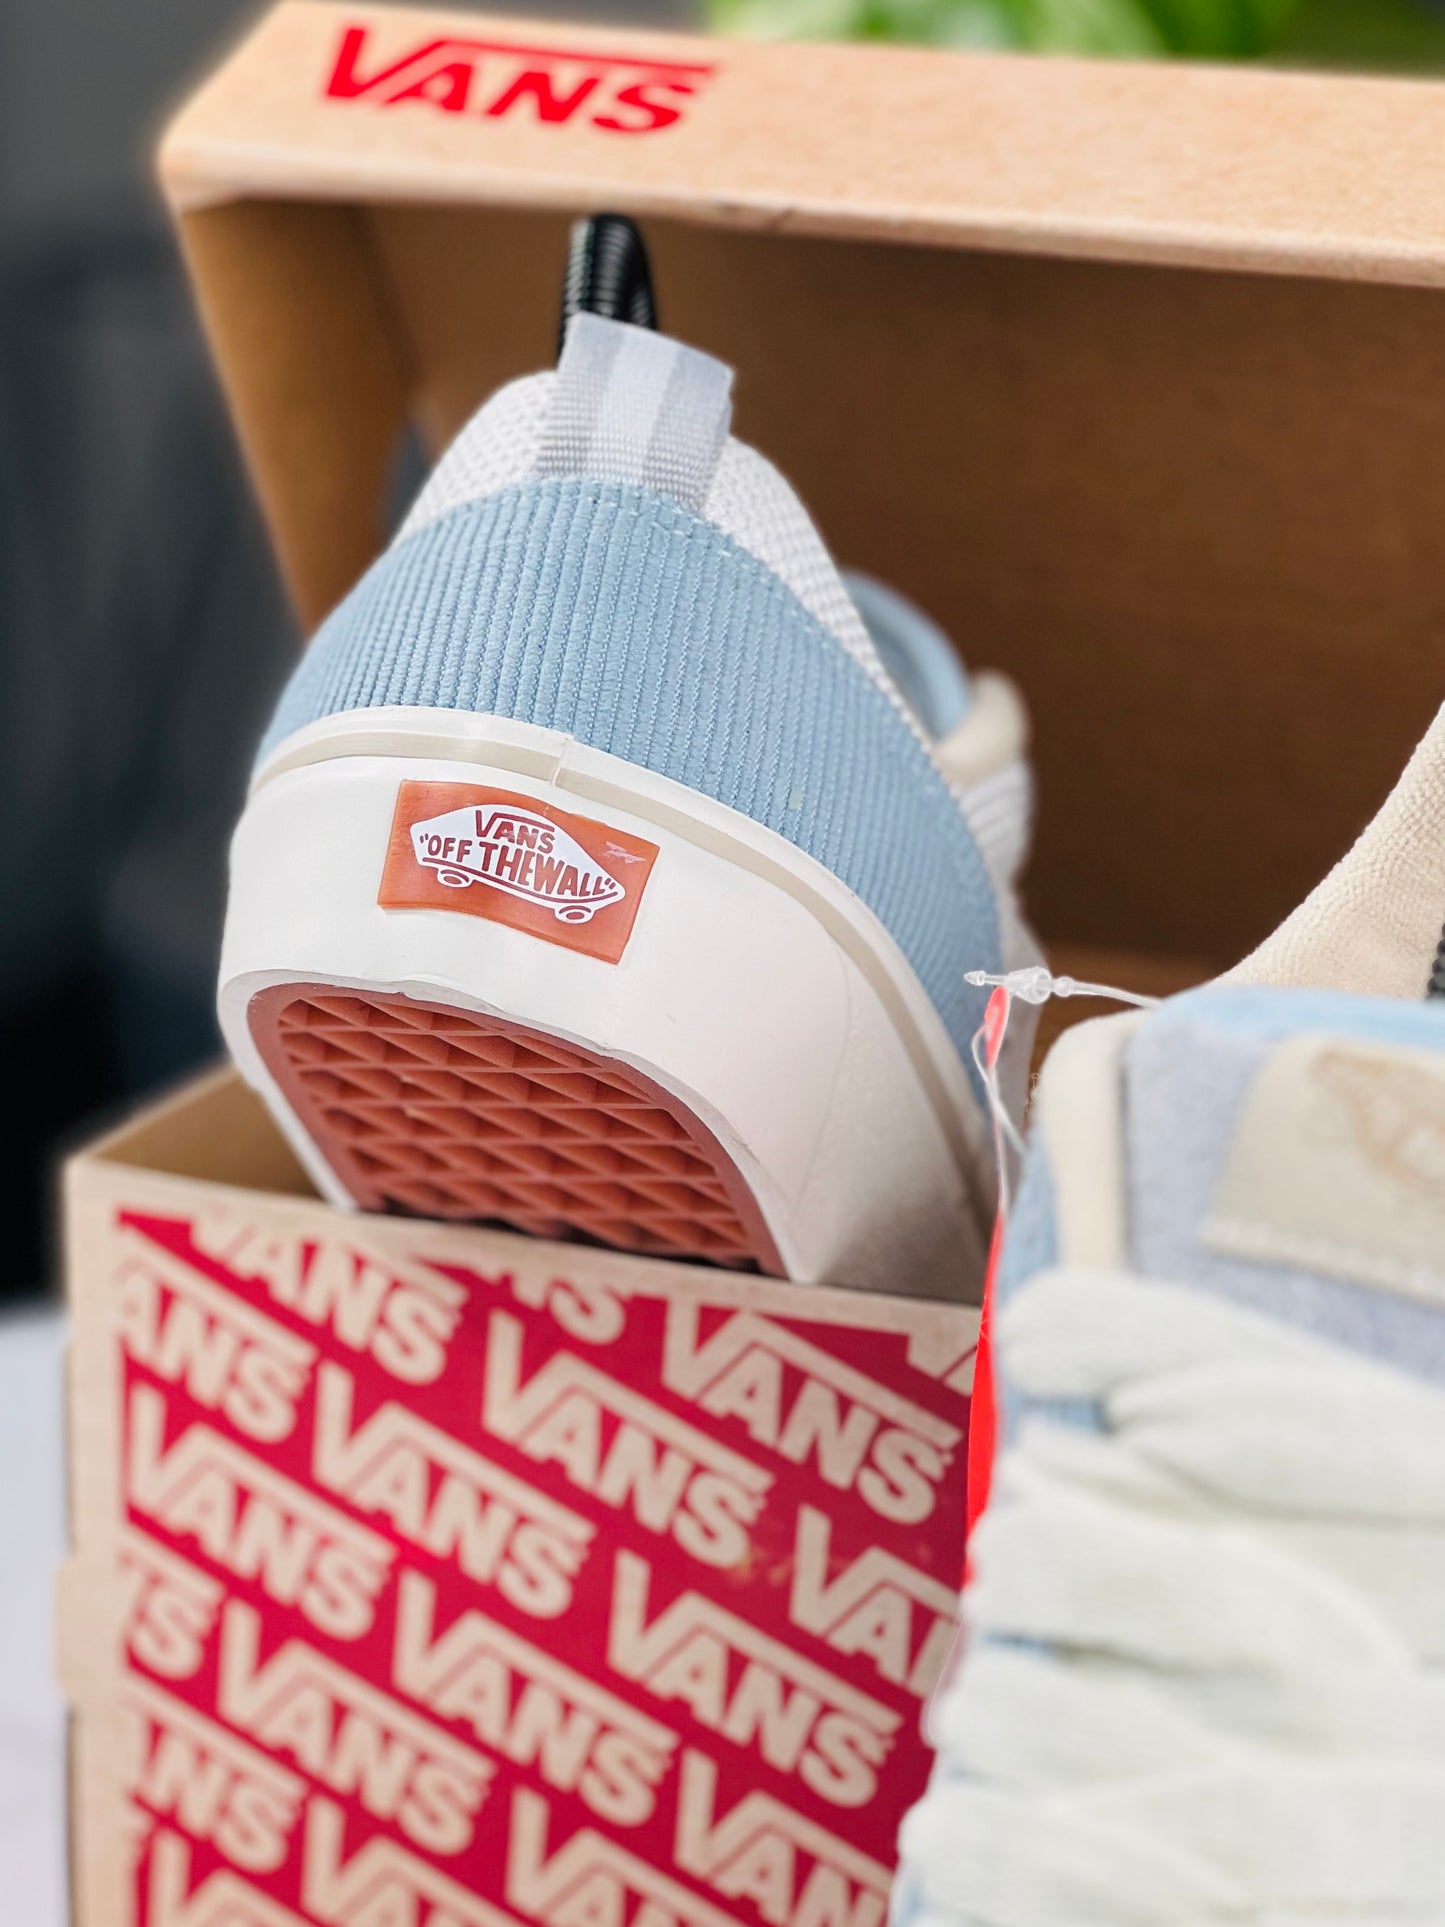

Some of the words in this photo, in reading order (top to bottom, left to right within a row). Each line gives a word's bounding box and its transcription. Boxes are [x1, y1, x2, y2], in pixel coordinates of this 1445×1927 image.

[324, 27, 716, 134] VANS
[474, 809, 556, 855] VANS
[113, 1226, 318, 1443] ANS
[311, 1356, 598, 1618] VANS
[606, 1548, 905, 1808] VANS
[483, 1305, 776, 1568] VANS
[660, 1298, 964, 1524] VANS
[127, 1381, 399, 1642] VANS
[393, 1567, 680, 1828] VANS
[213, 1597, 497, 1857] VANS
